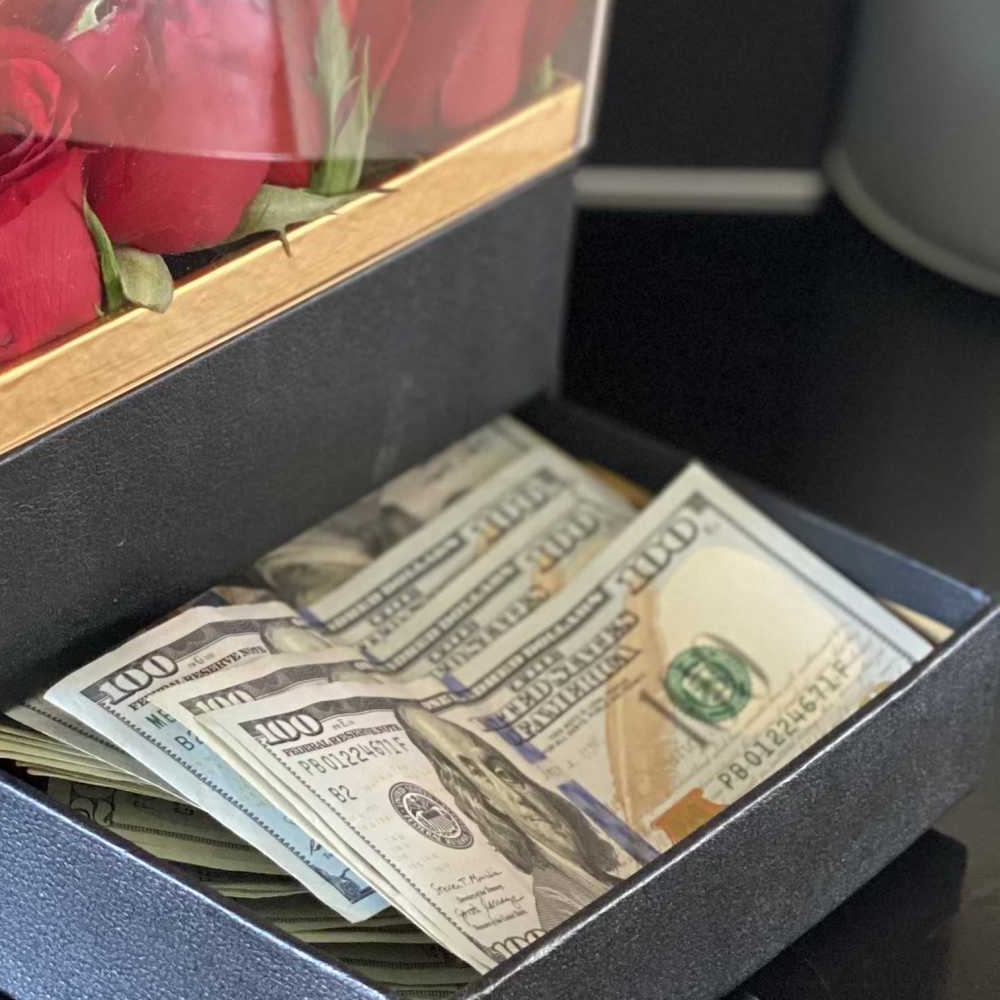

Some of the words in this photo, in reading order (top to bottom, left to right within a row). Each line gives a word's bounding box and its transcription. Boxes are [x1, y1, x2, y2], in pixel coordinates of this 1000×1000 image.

[617, 511, 699, 595] 100
[96, 654, 180, 706] 100
[254, 713, 324, 746] 100
[282, 739, 331, 757] FEDERAL
[328, 785, 358, 804] B2
